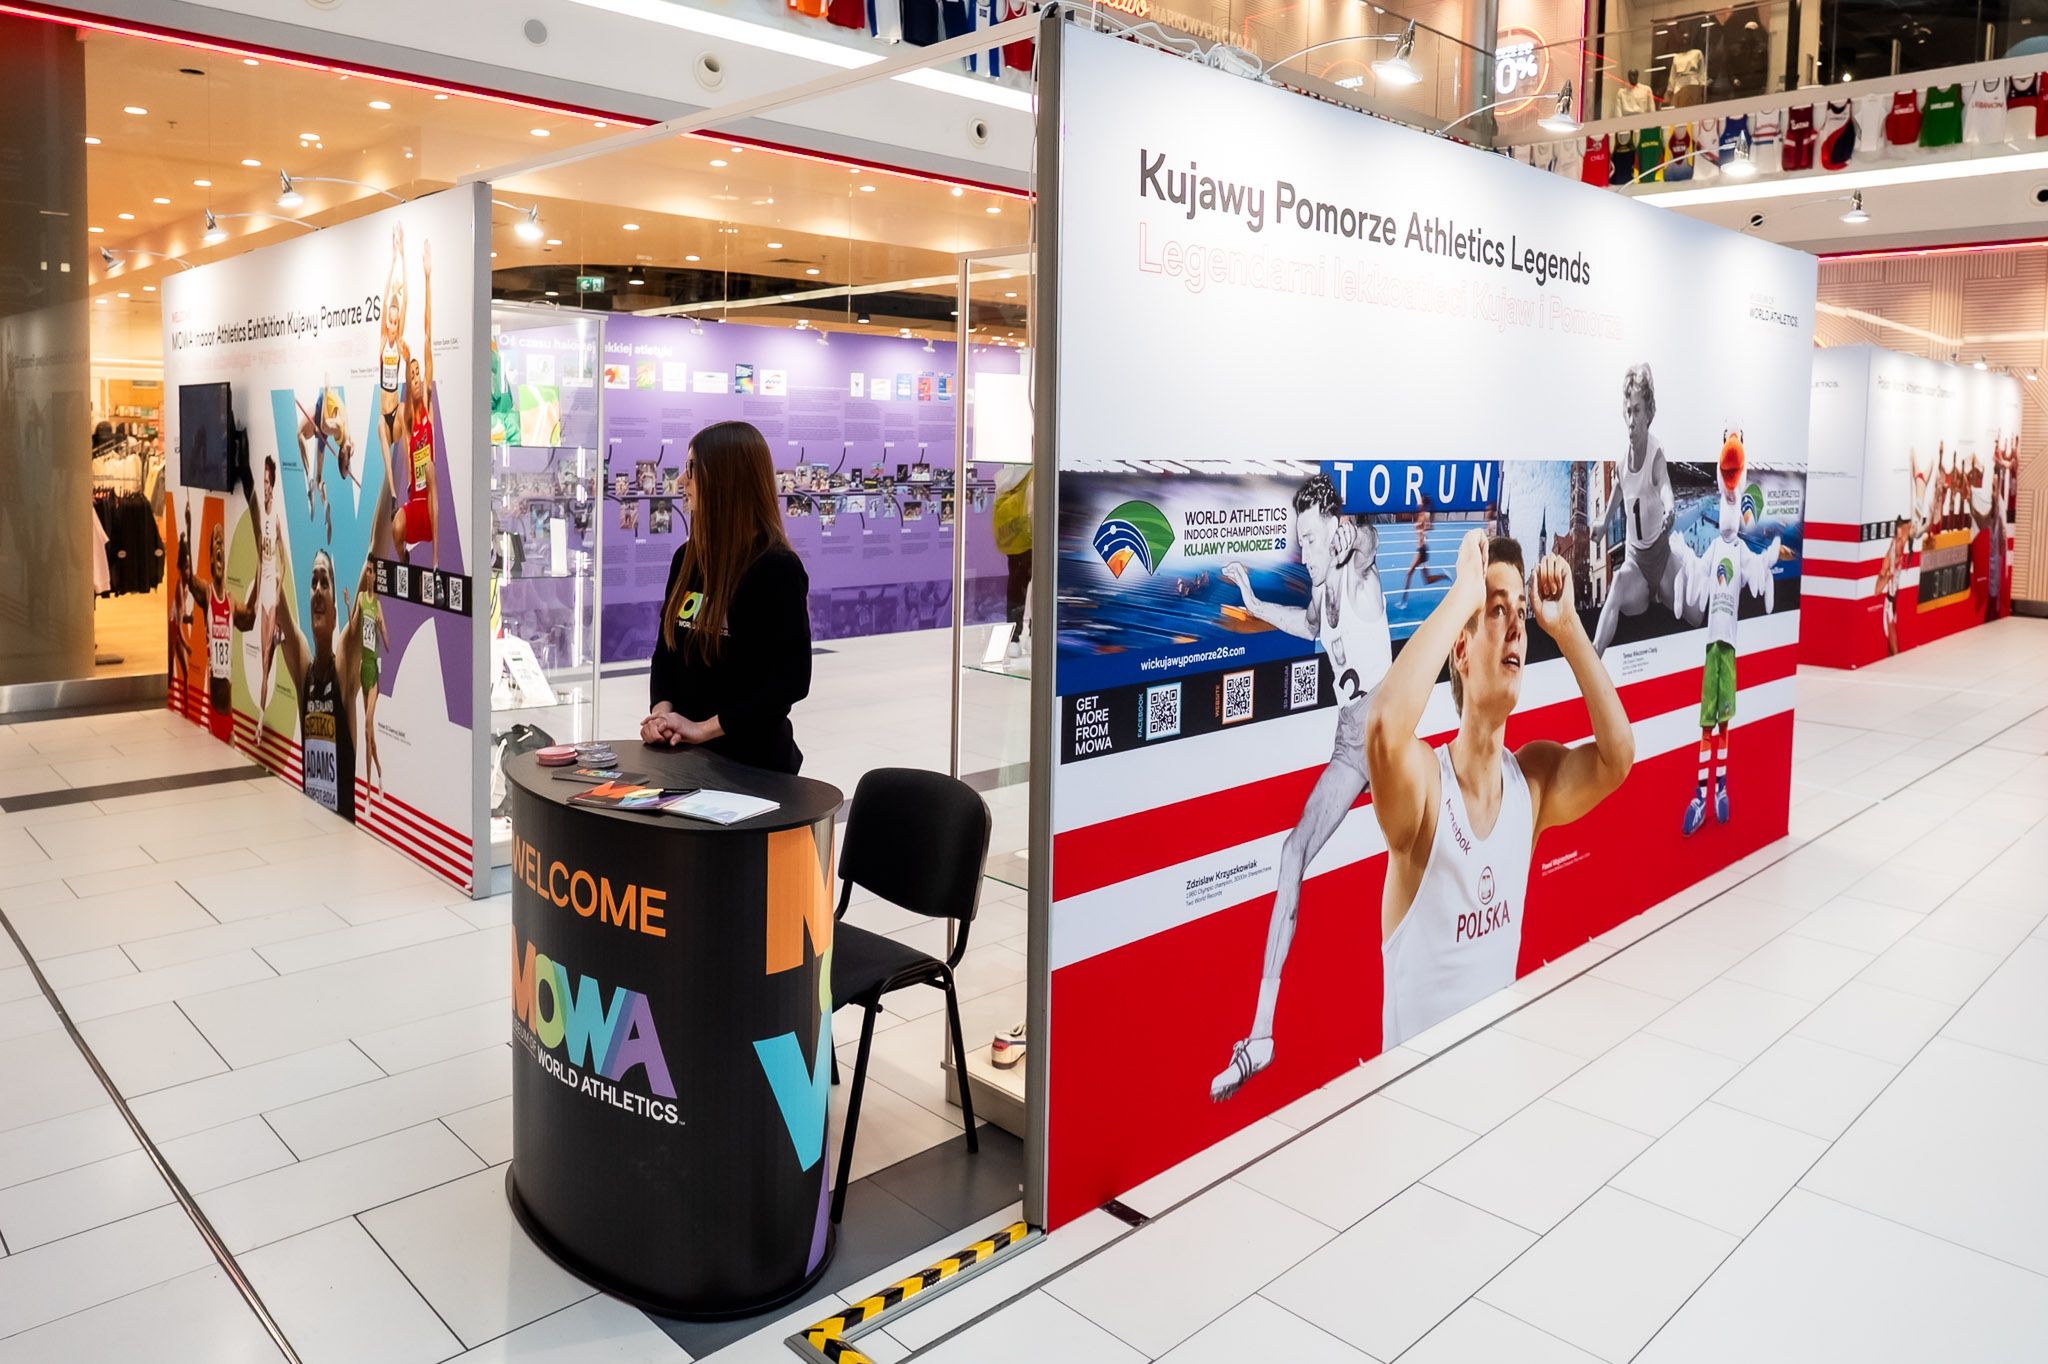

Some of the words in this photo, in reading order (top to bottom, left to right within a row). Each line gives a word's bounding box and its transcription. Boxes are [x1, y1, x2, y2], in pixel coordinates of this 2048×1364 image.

[1140, 148, 1265, 233] Kujawy
[1276, 180, 1397, 246] Pomorze
[1405, 212, 1505, 268] Athletics
[1511, 235, 1590, 286] Legends
[1139, 222, 1325, 297] Legendarni
[217, 324, 246, 344] Athletics
[248, 316, 286, 340] Exhibition
[287, 312, 319, 339] Kujawy
[321, 305, 362, 330] Pomorze
[365, 296, 381, 322] 26
[604, 342, 632, 356] ekkiej
[1334, 462, 1491, 506] TORUN
[1185, 510, 1227, 526] WORLD
[1229, 507, 1288, 524] ATHLETICS
[1633, 498, 1643, 540] 1
[1184, 528, 1219, 540] INDOOR
[1220, 524, 1287, 538] CHAMPIONSHIPS
[1184, 541, 1225, 557] KUJAWY
[1227, 538, 1273, 554] POMORZE
[1274, 537, 1287, 550] 26
[214, 642, 229, 666] 183
[1140, 646, 1246, 671] wickujawypomorze26.com
[315, 700, 333, 713] ZEALAND
[1076, 695, 1099, 712] GET
[305, 716, 335, 738] SEIKO
[1076, 708, 1109, 727] MORE
[1075, 722, 1109, 741] FROM
[1075, 737, 1112, 755] MOWA
[306, 750, 336, 783] ADAMS
[512, 834, 666, 938] WELCOME
[1186, 875, 1214, 890] Zdzislaw
[1216, 859, 1258, 880] Krzyszkowiak
[1456, 900, 1511, 943] POLSKA
[512, 924, 678, 1099] MOWA
[537, 1045, 579, 1088] WORLD
